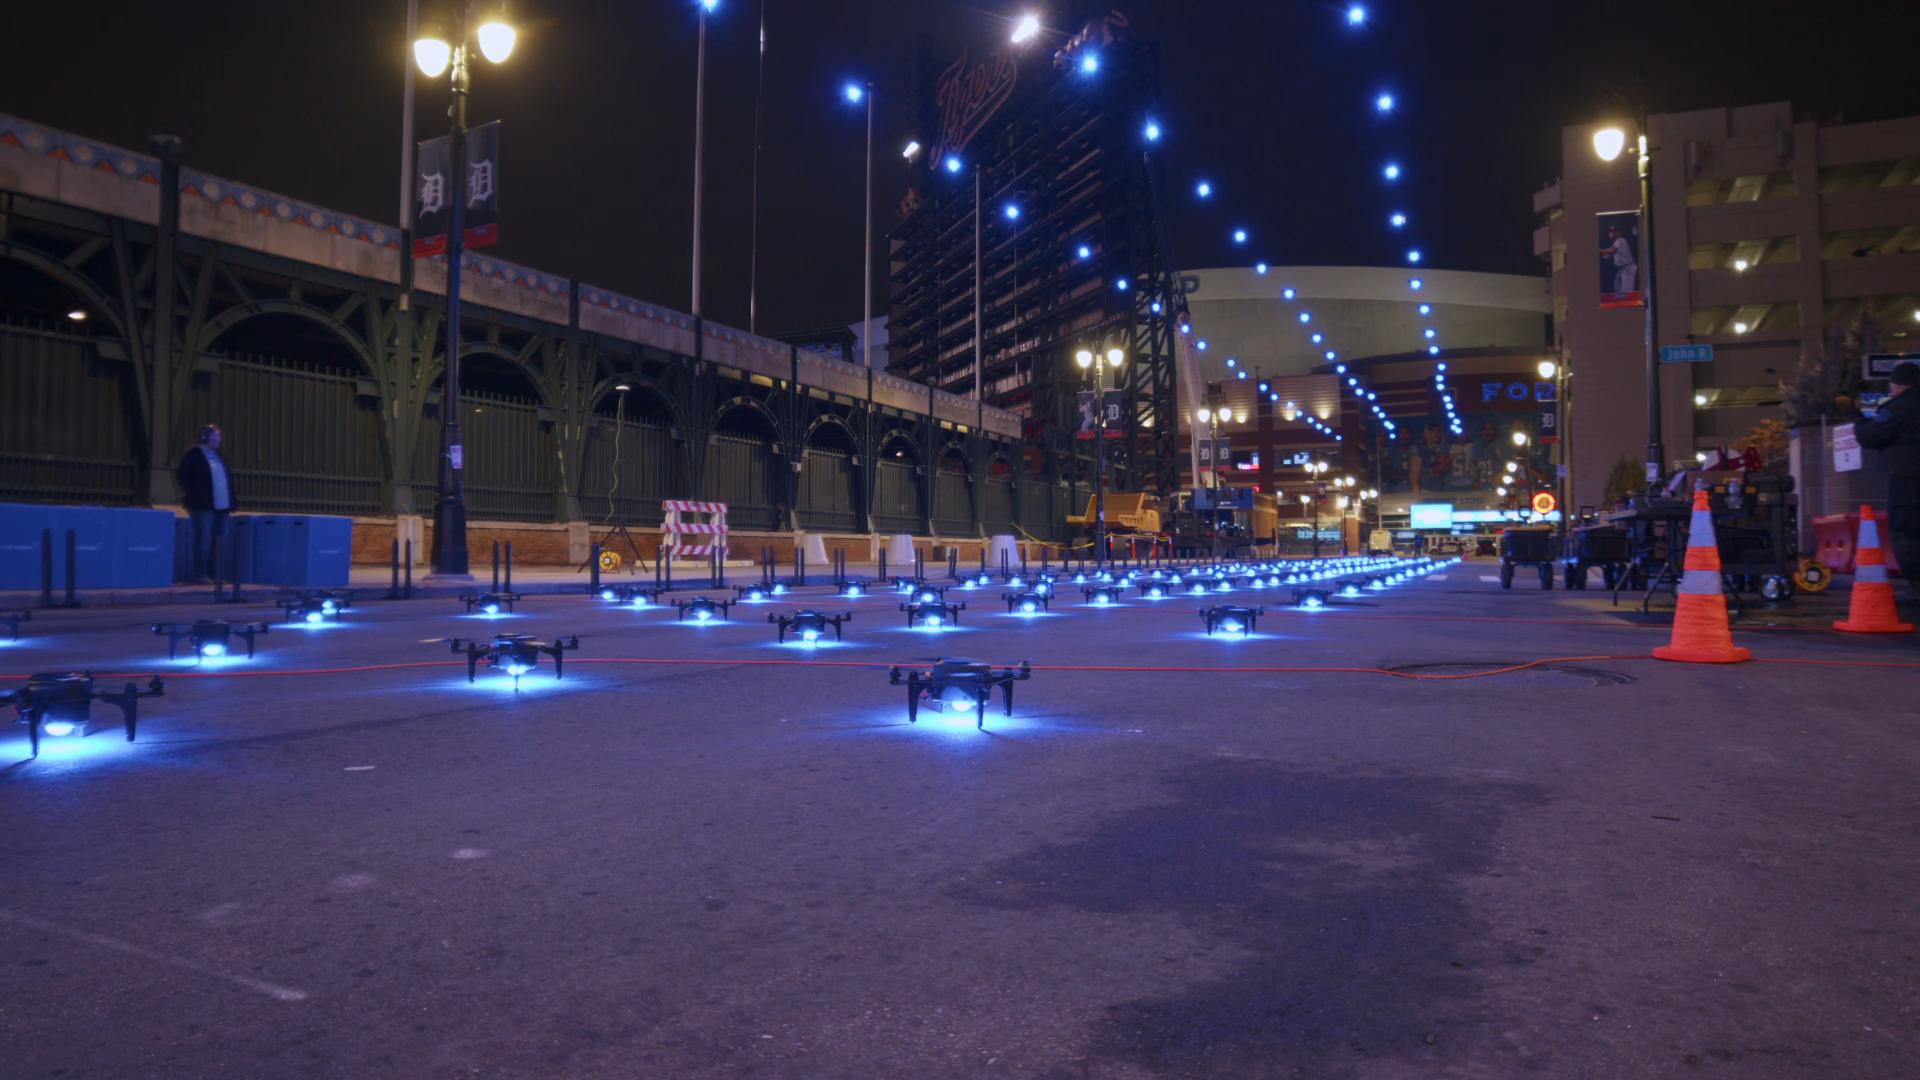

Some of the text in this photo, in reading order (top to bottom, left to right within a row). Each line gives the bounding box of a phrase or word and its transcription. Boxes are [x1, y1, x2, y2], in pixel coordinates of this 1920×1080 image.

[419, 172, 444, 220] D
[468, 158, 493, 208] D
[1667, 347, 1694, 361] John
